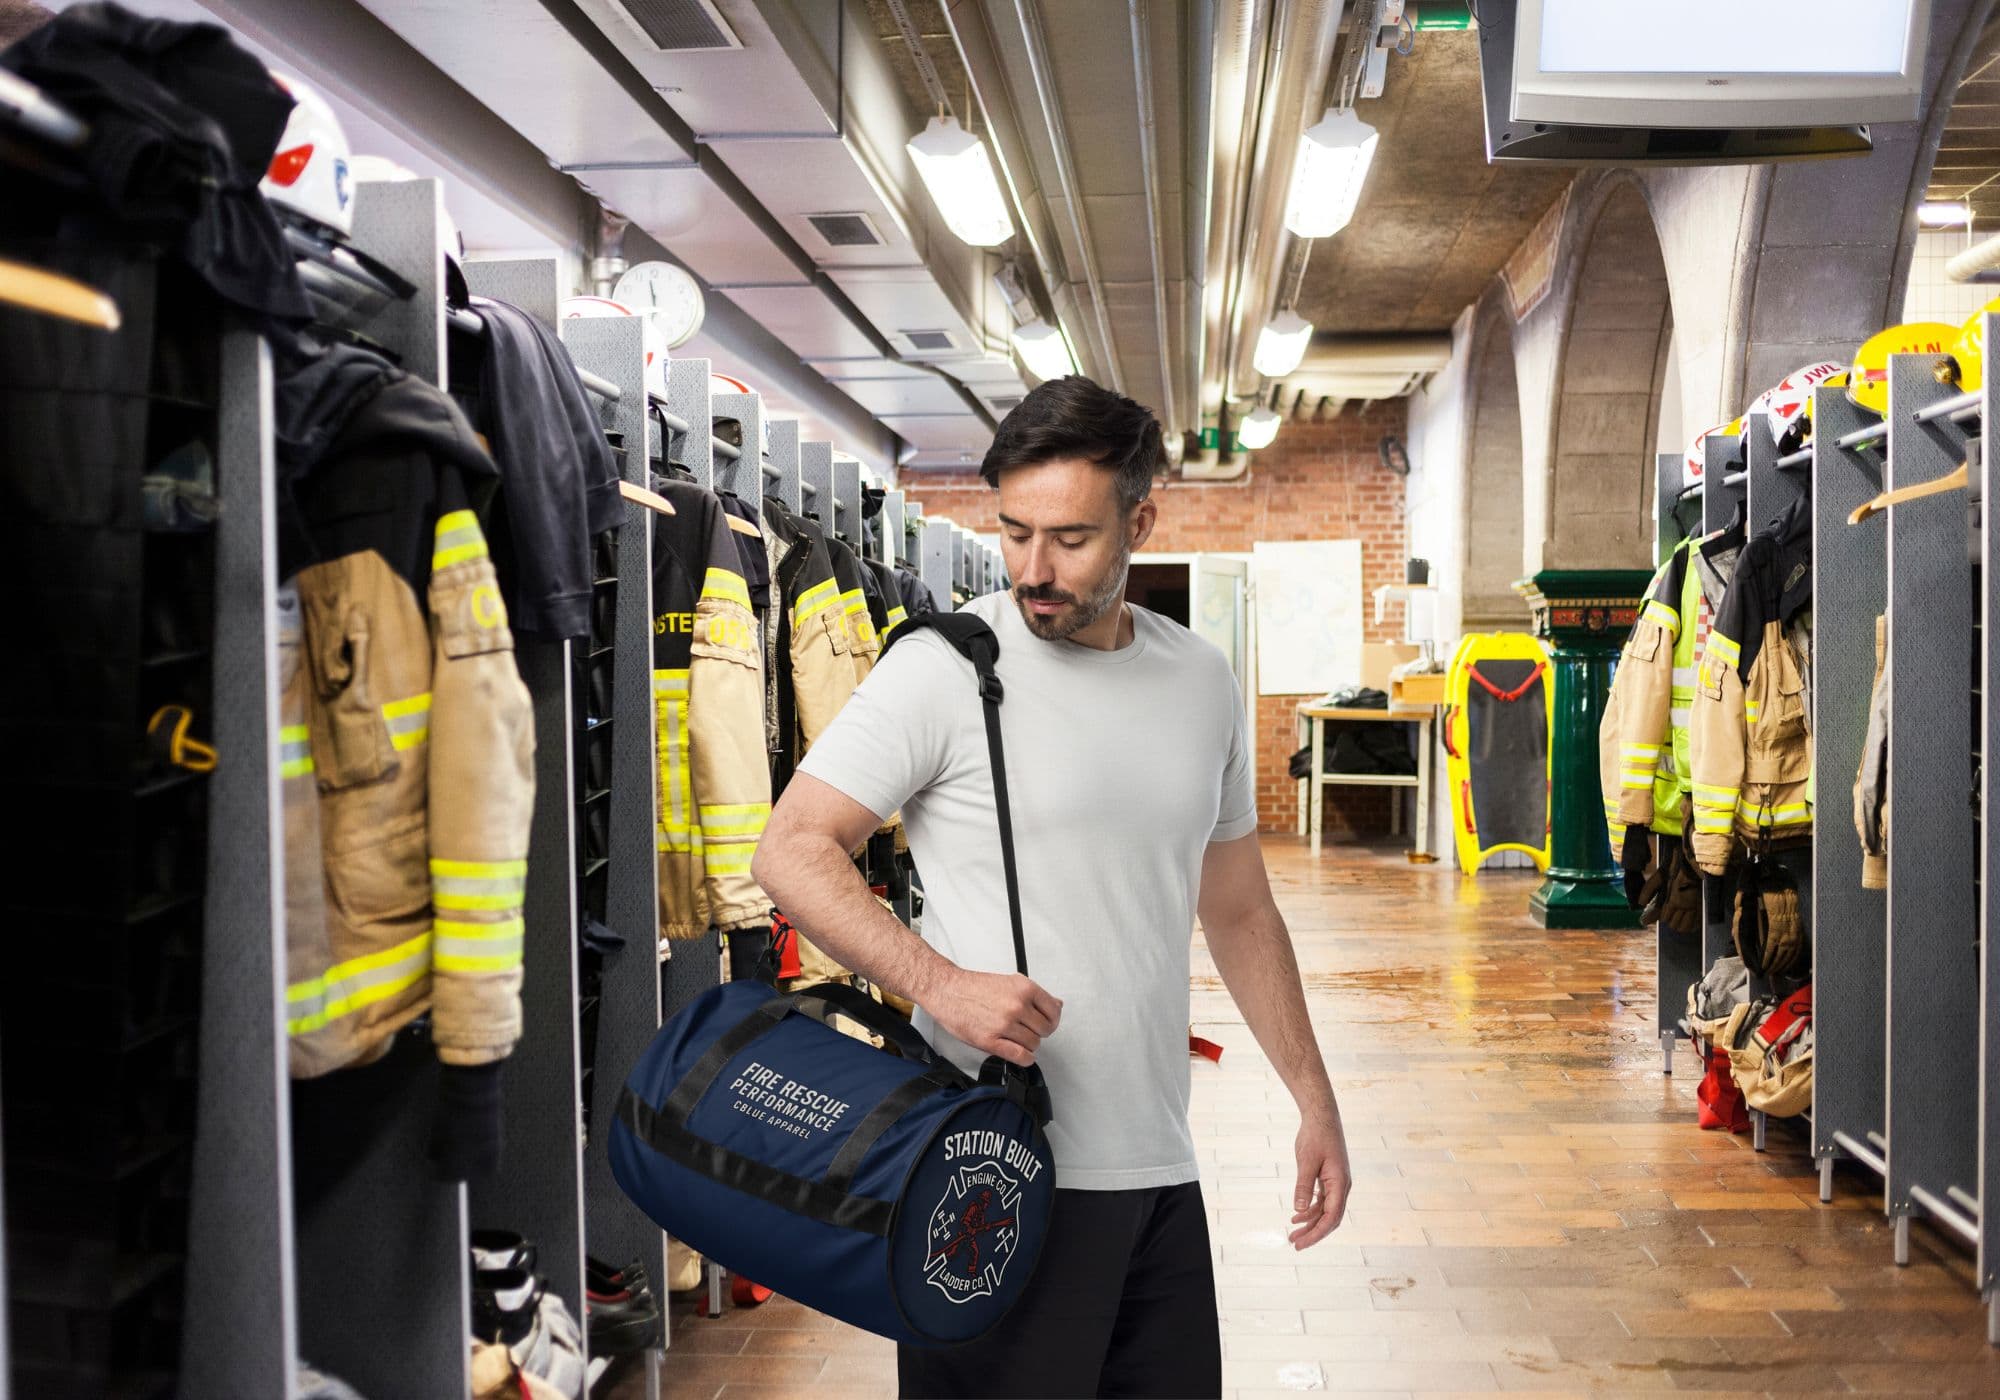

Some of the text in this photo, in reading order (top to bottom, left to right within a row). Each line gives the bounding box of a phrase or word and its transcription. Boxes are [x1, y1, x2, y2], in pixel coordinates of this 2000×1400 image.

[1803, 363, 1841, 386] JWL
[653, 612, 697, 635] STE
[729, 1078, 836, 1132] PERFORMANCE
[741, 1062, 850, 1119] FIRE RESCUE
[733, 1100, 812, 1139] CBLUE APPAREL
[944, 1130, 1043, 1183] STATION BUILT
[967, 1172, 997, 1188] ENGINE
[939, 1267, 971, 1292] LADDER
